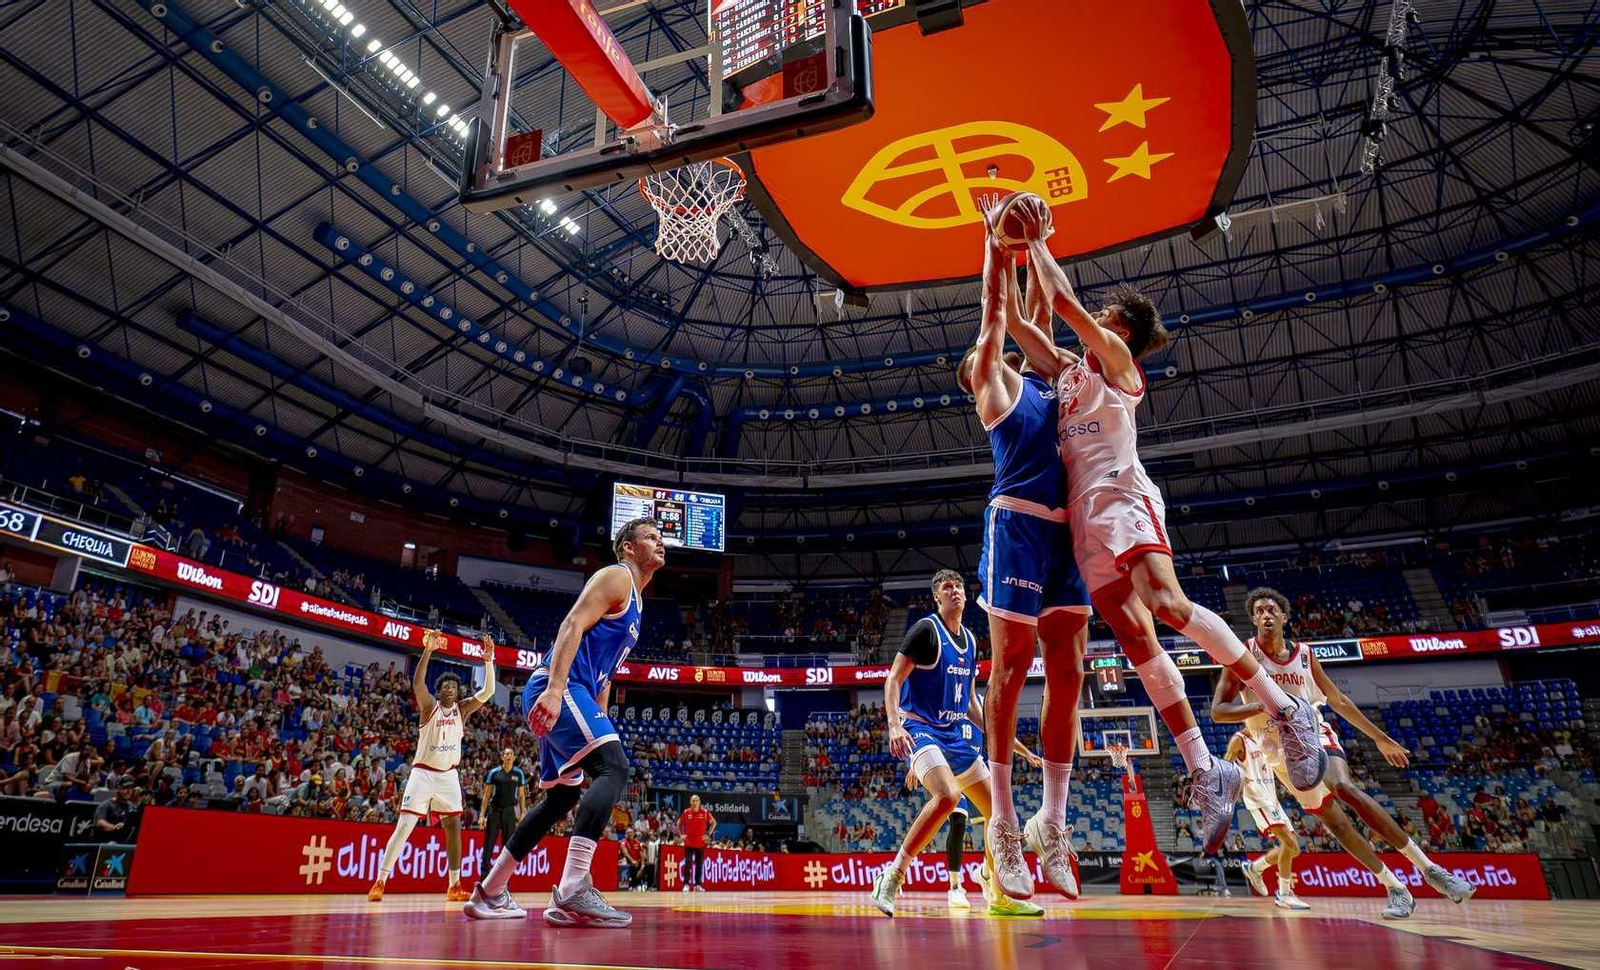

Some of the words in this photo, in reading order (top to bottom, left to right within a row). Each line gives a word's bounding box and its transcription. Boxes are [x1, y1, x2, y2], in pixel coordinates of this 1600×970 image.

[580, 3, 620, 62] renfe
[1045, 166, 1074, 199] FEB
[1059, 420, 1100, 442] desa
[62, 531, 114, 558] CHEQUIA
[177, 562, 223, 590] Wilson
[248, 580, 281, 608] SDI
[382, 621, 411, 641] AVIS
[1497, 626, 1540, 648] SDI
[1312, 645, 1347, 658] EQUIA
[1409, 636, 1467, 653] Wilson
[516, 649, 542, 670] SDI
[648, 667, 679, 681] AVIS
[742, 671, 782, 683] Wilson
[805, 668, 833, 684] SDI
[1099, 668, 1117, 683] 11
[1270, 672, 1305, 686] PAÑA
[961, 724, 972, 740] 19
[715, 803, 751, 814] Solidaria
